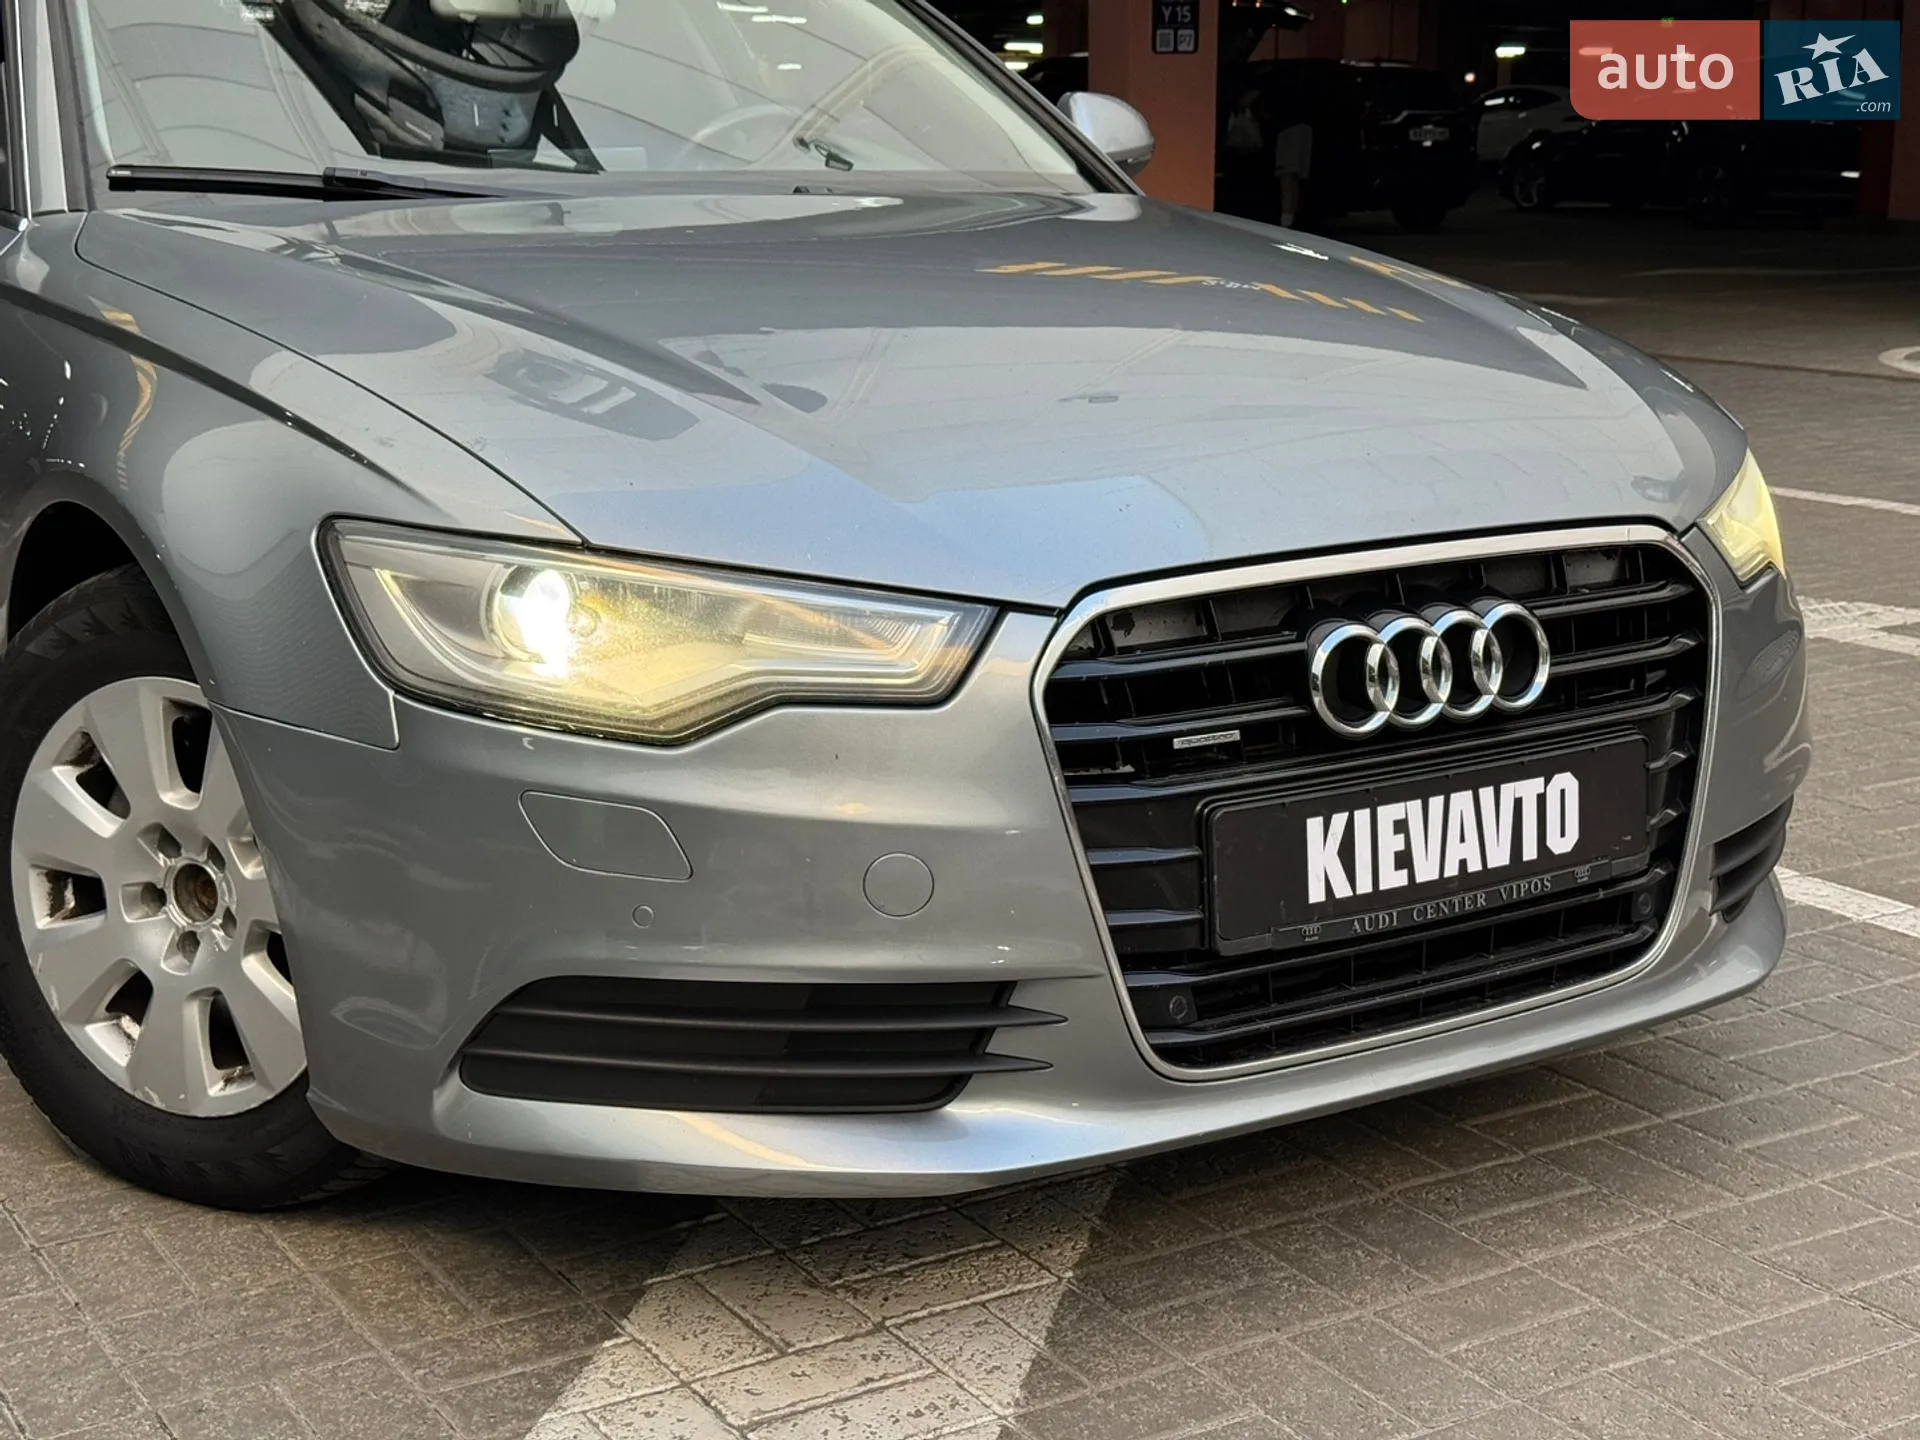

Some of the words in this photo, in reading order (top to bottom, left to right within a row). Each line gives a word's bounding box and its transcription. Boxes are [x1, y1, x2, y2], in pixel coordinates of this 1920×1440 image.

[1161, 6, 1172, 23] Y
[1175, 5, 1191, 22] 15
[1306, 771, 1580, 904] KIEVAVTO
[1352, 911, 1398, 933] AUDI
[1413, 892, 1487, 921] CENTER
[1500, 875, 1551, 901] VIPOS
